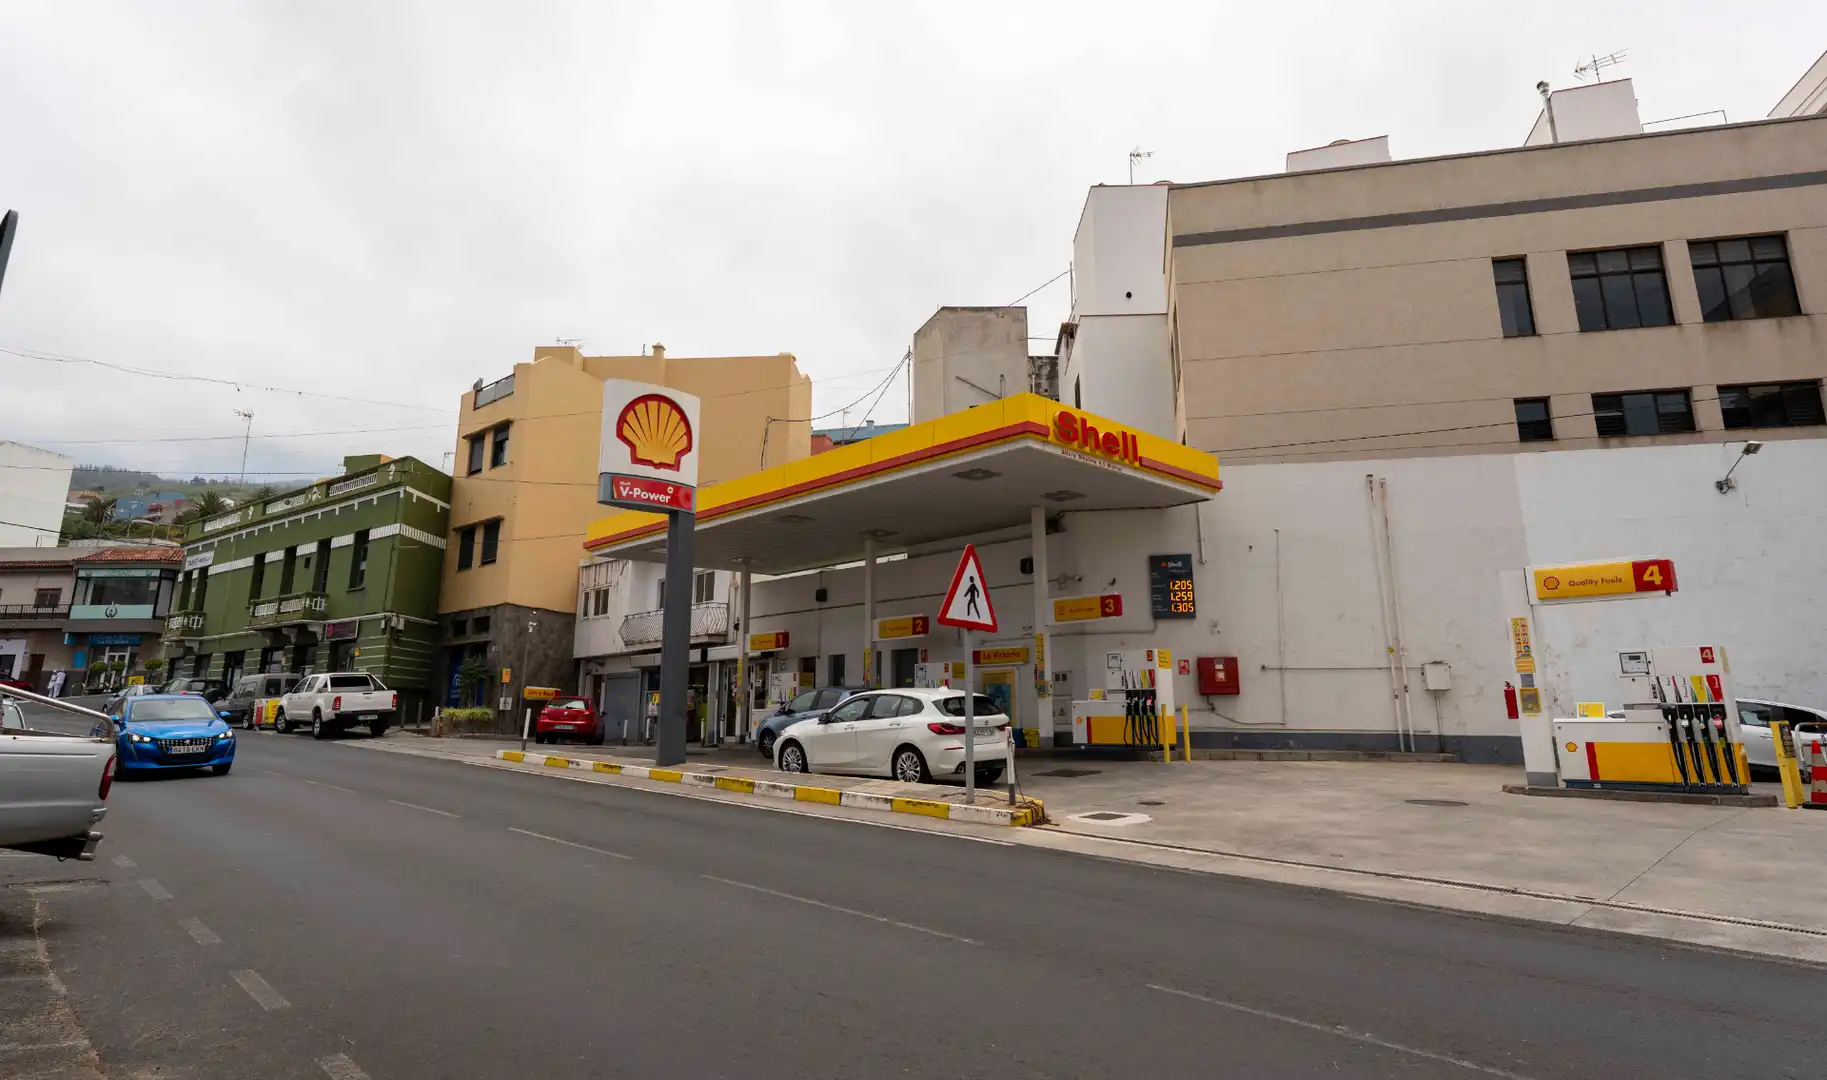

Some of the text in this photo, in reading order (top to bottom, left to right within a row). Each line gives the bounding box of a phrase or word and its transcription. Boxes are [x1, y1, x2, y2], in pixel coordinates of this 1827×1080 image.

[1054, 411, 1139, 463] Shell
[619, 485, 671, 503] V-Power
[1642, 564, 1663, 585] 4
[1170, 580, 1193, 590] 1.205
[1568, 576, 1623, 588] Quality Fuels
[1171, 591, 1193, 601] 1.259
[1105, 598, 1115, 613] 3
[1171, 602, 1194, 613] 1.305
[915, 619, 924, 632] 2
[983, 650, 1022, 660] La Victoria
[1702, 648, 1713, 660] 4
